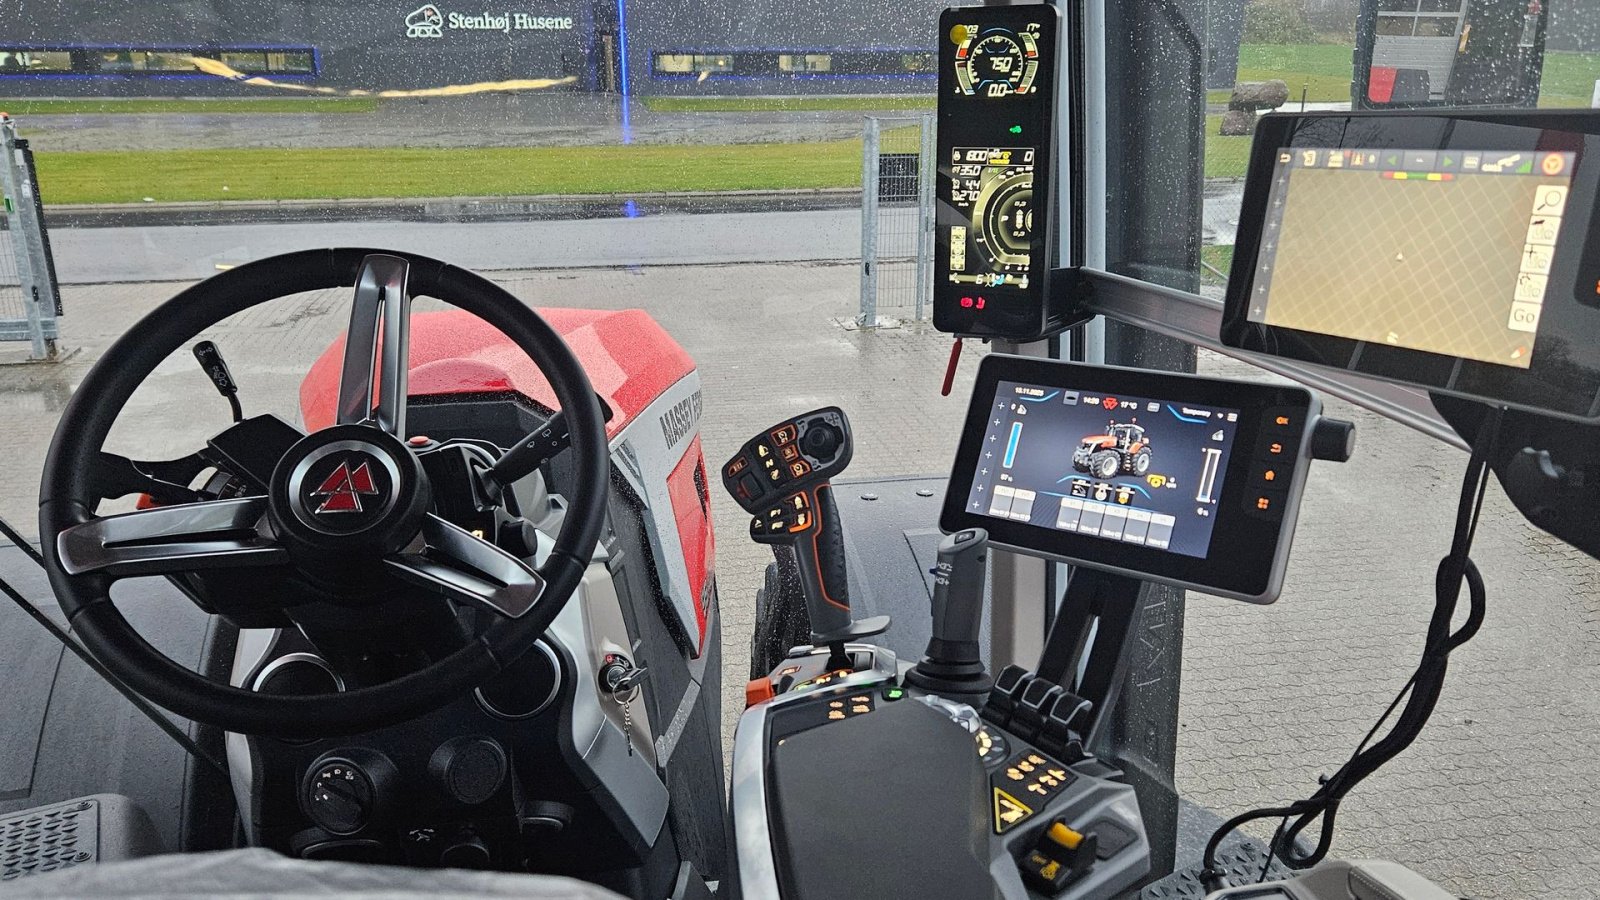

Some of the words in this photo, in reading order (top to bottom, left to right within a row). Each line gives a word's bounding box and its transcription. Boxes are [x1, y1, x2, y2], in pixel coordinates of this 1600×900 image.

[449, 12, 509, 33] Stenhøj
[514, 13, 572, 30] Husene
[990, 57, 1013, 71] 750
[966, 150, 988, 162] 800
[1513, 308, 1536, 324] Go
[659, 396, 693, 450] MASSEY
